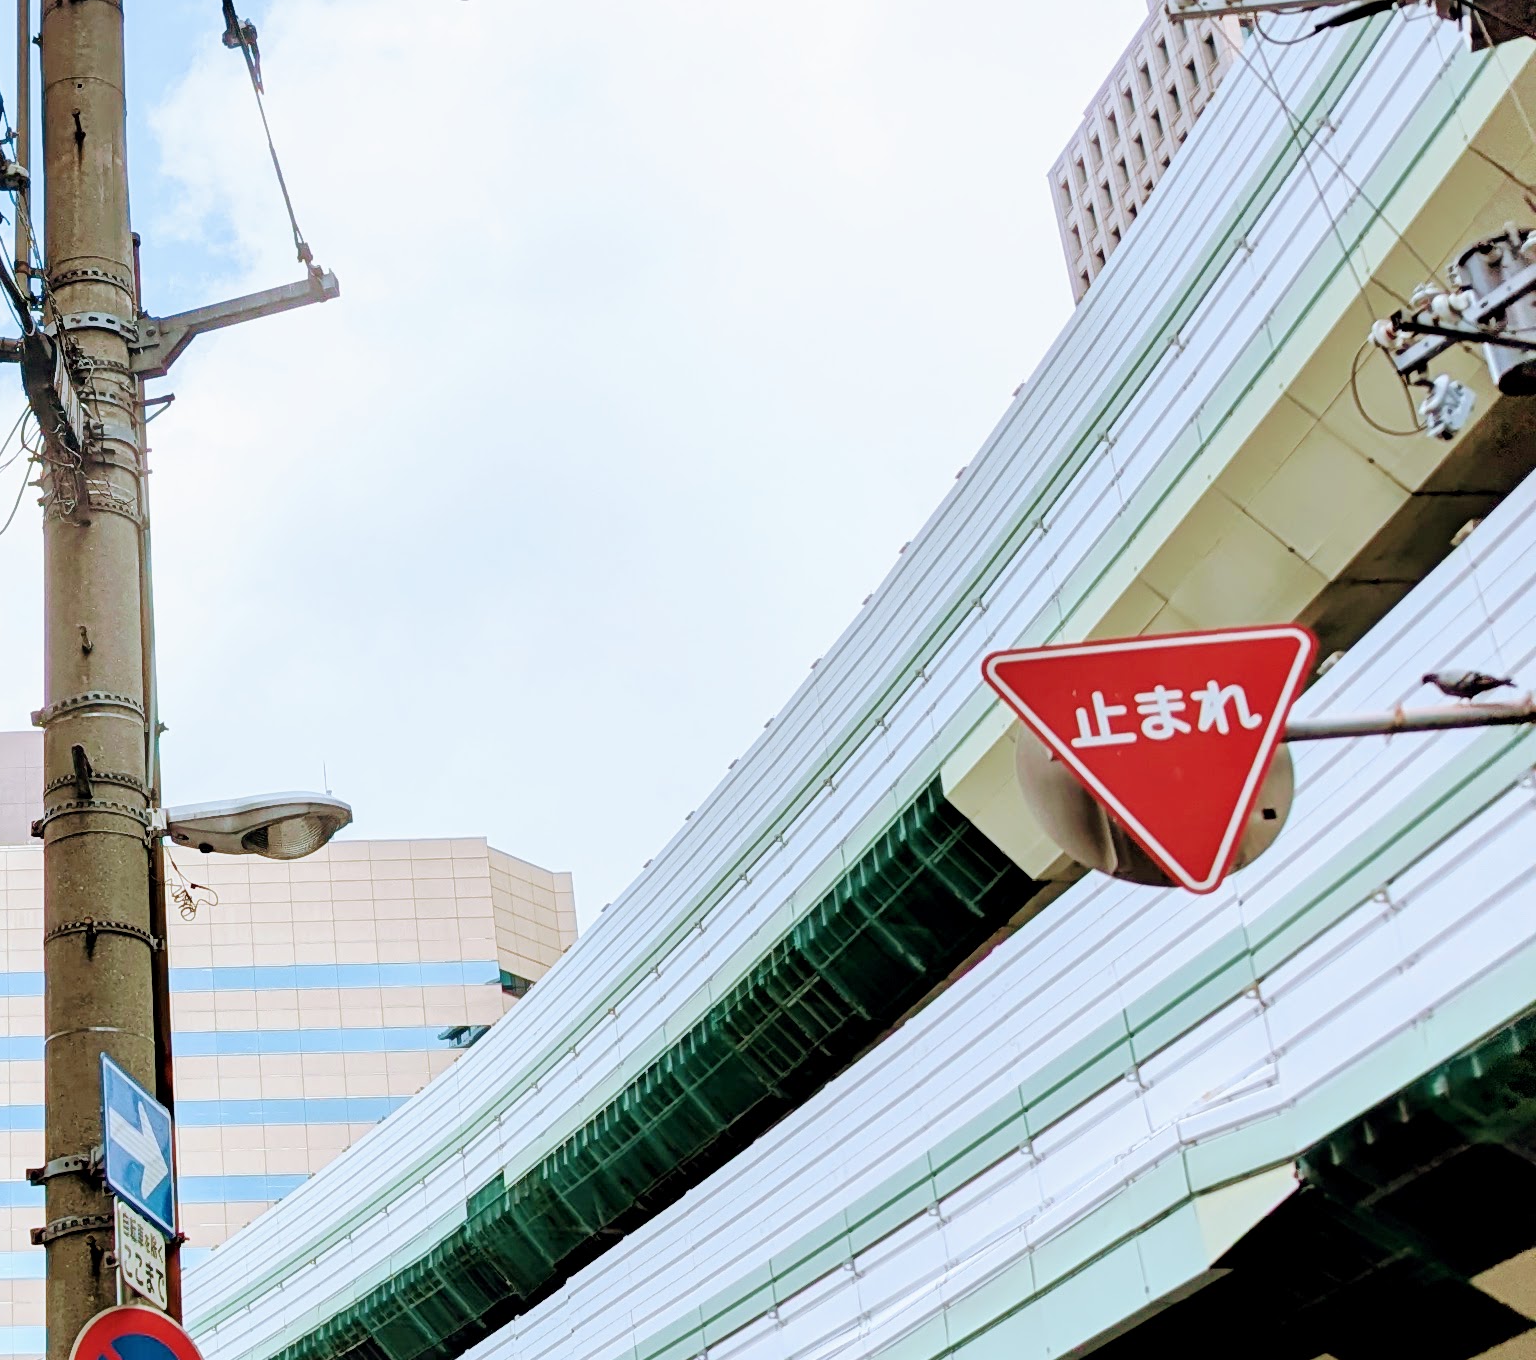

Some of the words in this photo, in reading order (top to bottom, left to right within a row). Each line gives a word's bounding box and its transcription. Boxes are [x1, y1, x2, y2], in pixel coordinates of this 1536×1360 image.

[1071, 680, 1262, 748] 止まれ
[124, 1244, 164, 1303] ここまで
